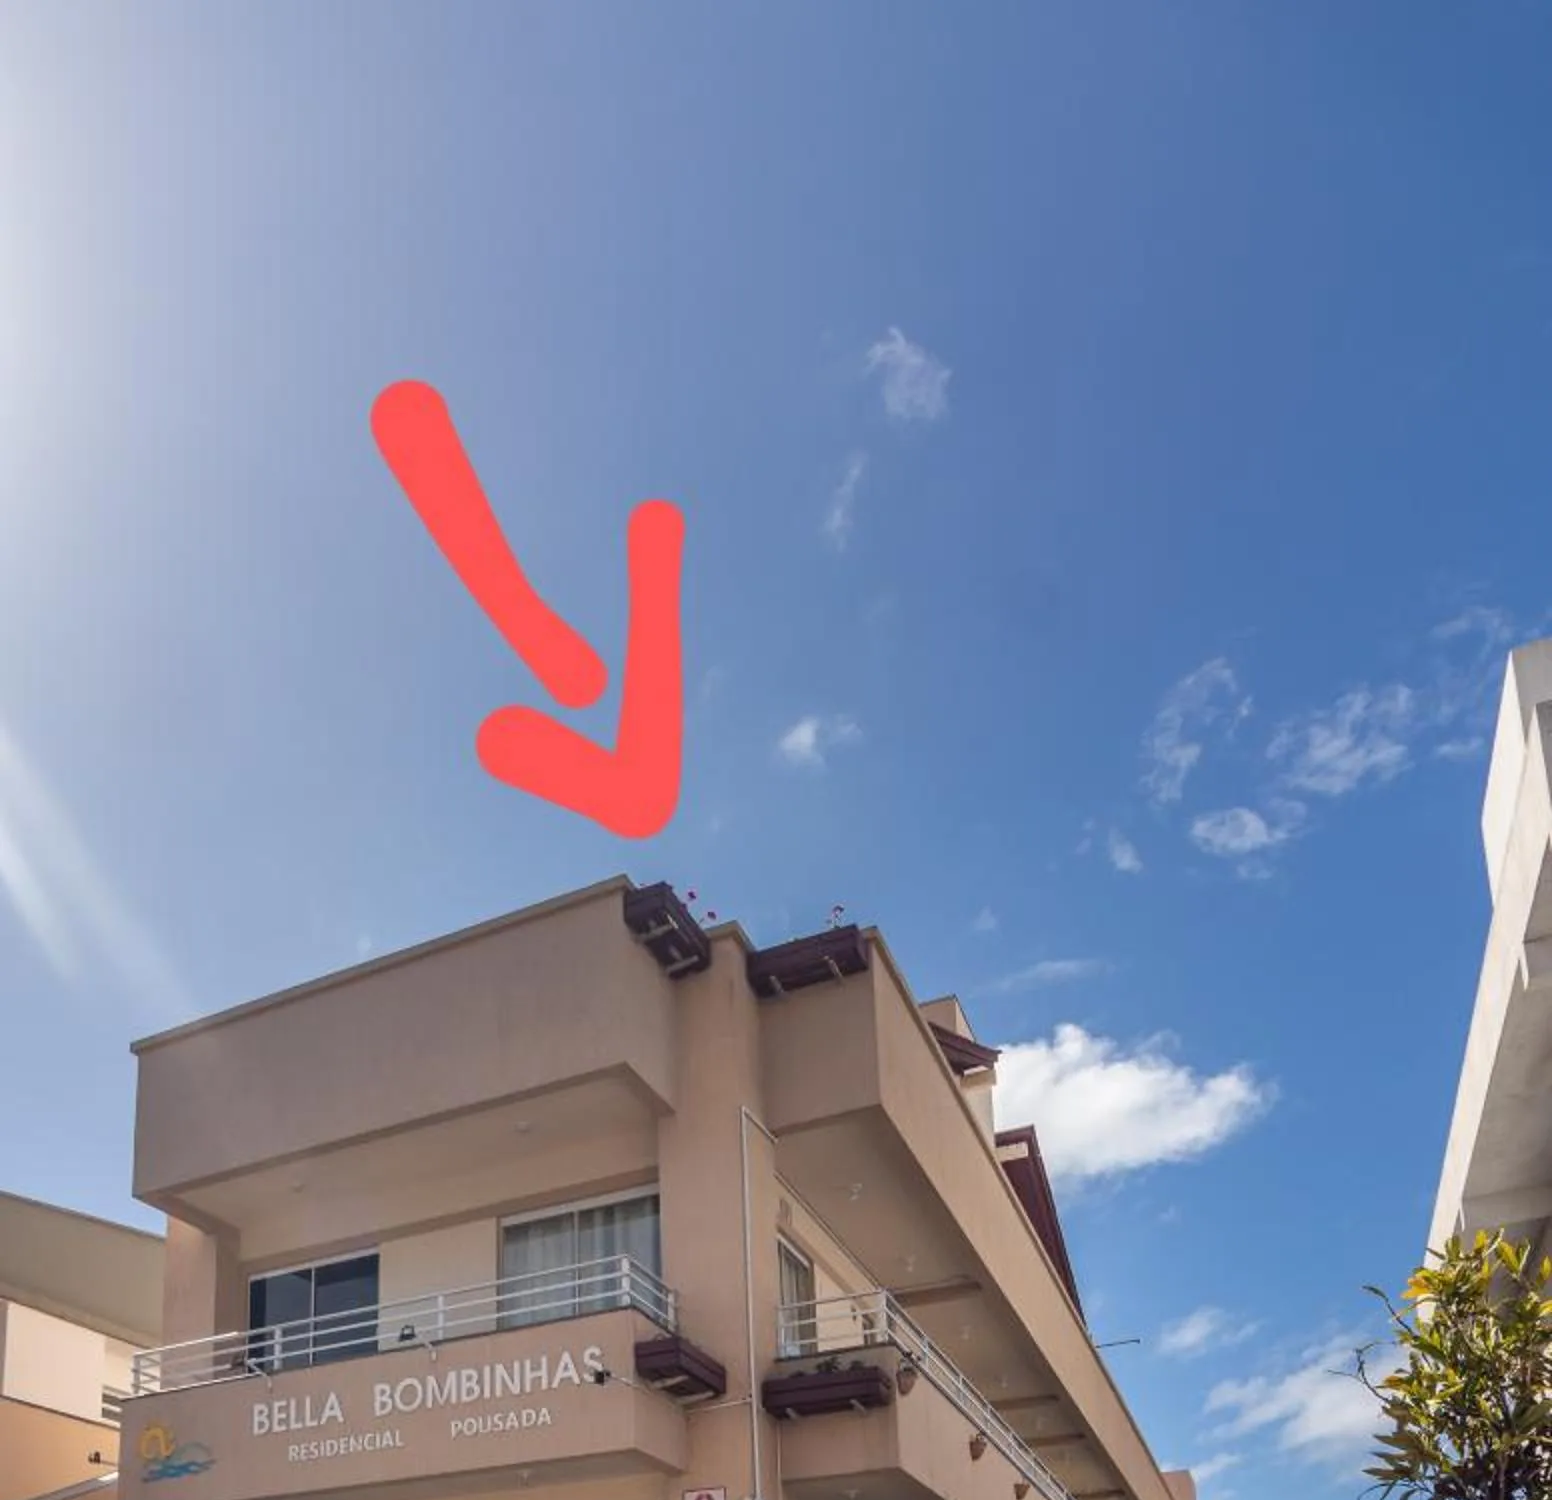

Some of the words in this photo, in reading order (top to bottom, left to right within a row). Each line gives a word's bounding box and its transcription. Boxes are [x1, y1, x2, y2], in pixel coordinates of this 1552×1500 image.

[253, 1391, 345, 1436] BELLA
[373, 1346, 605, 1417] BOMBINHAS
[451, 1407, 552, 1438] POUSADA
[288, 1429, 405, 1462] RESIDENCIAL
